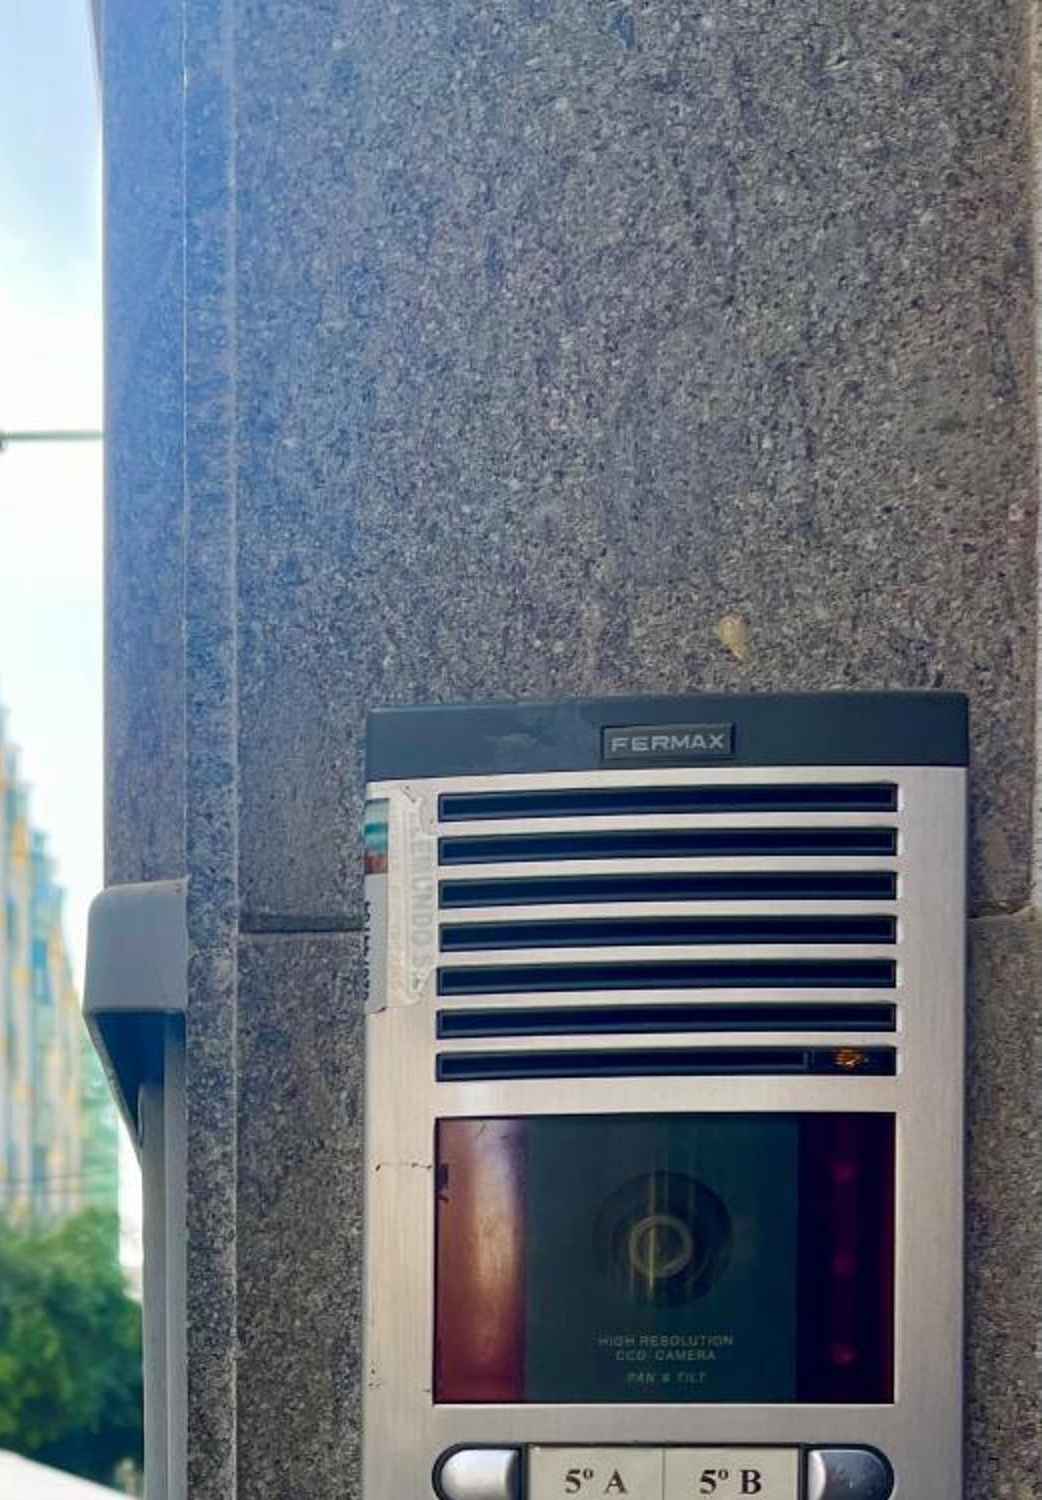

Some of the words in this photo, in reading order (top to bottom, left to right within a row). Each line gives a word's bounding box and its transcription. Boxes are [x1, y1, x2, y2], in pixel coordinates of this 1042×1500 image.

[611, 733, 725, 752] FERMAX
[598, 1335, 635, 1346] HIGH
[639, 1334, 734, 1346] RESOLUTION
[615, 1348, 647, 1361] CCD
[655, 1348, 716, 1361] CAMERA
[628, 1371, 655, 1384] PAN
[678, 1371, 706, 1384] TILT
[604, 1469, 628, 1495] A
[740, 1469, 763, 1495] B
